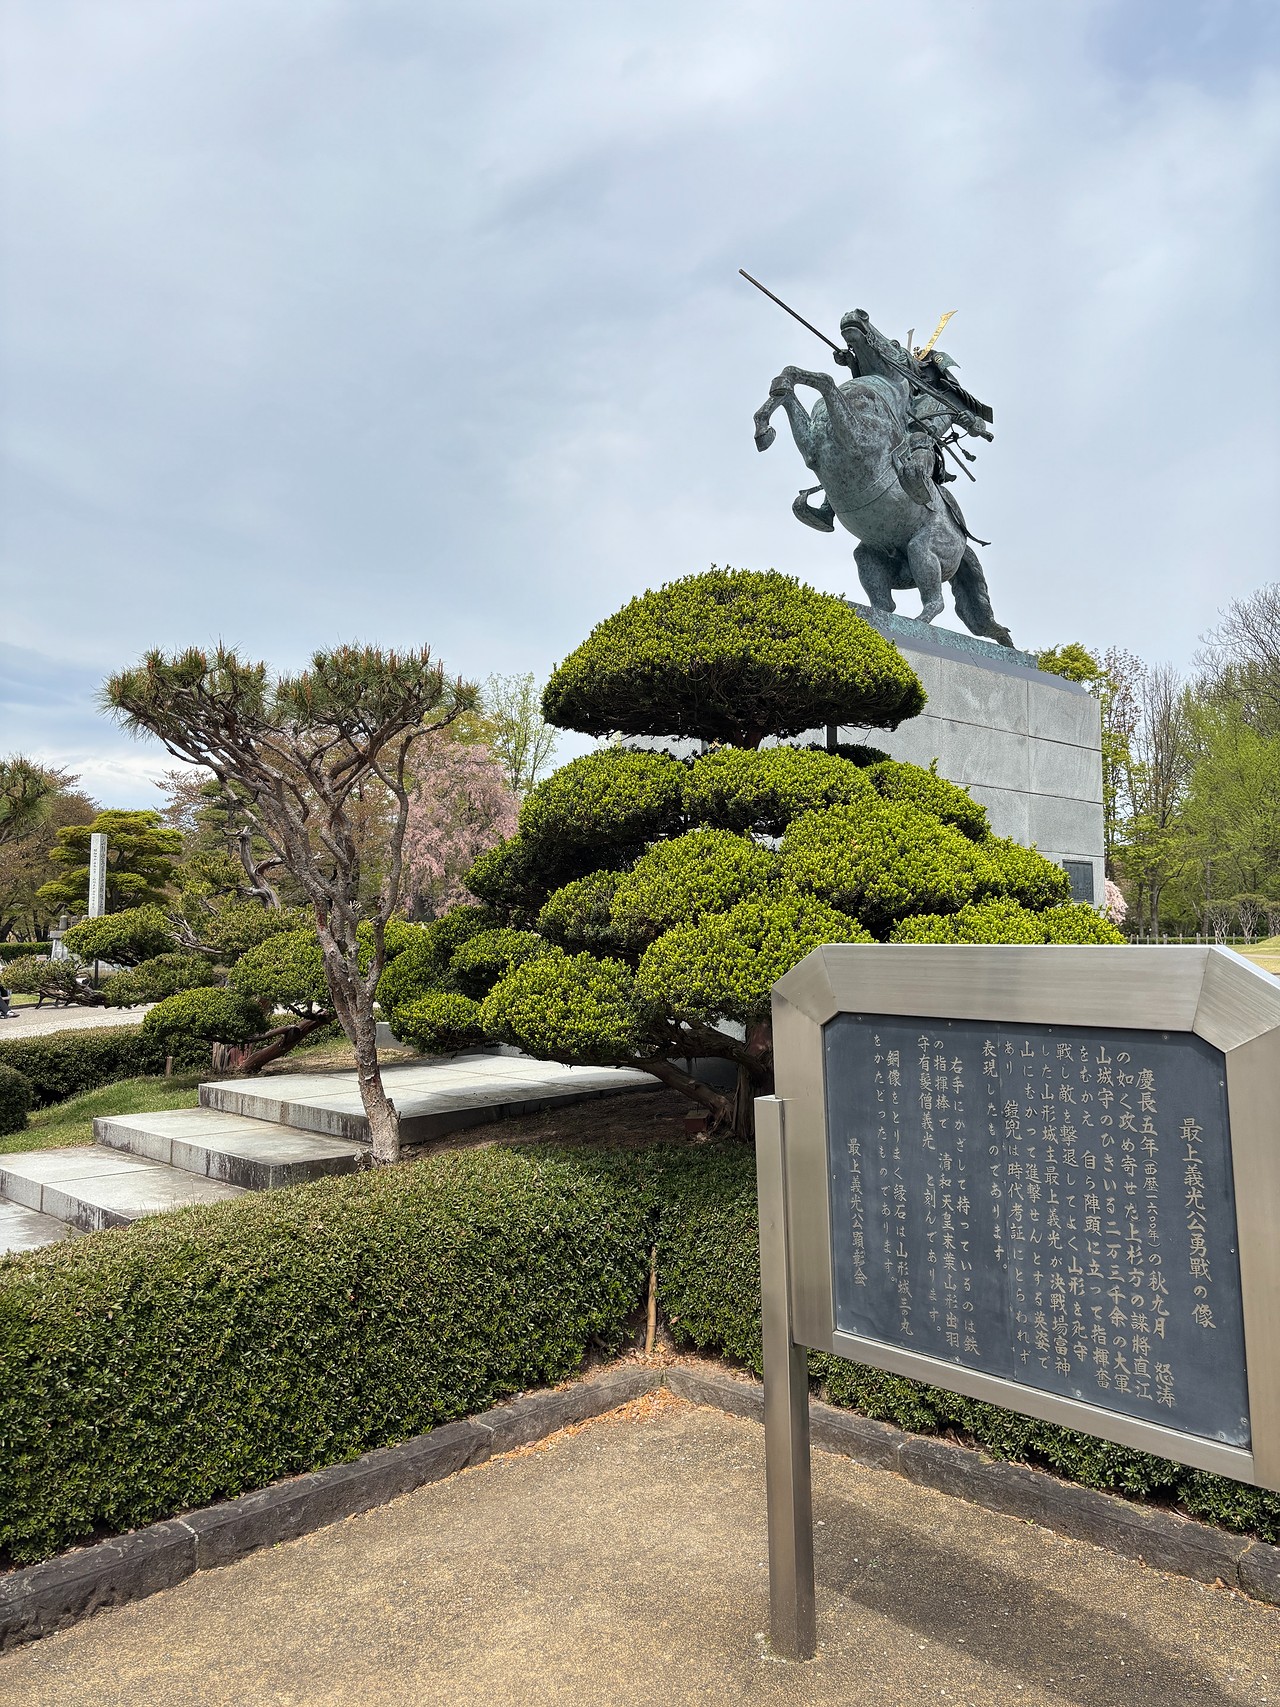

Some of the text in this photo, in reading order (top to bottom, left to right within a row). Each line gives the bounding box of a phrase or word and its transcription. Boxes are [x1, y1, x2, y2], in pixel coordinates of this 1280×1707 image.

[933, 1040, 951, 1130] の指揮棒で
[1004, 1042, 1015, 1076] あり
[1079, 1046, 1095, 1127] をむかえ
[1154, 1361, 1176, 1408] 怒涛
